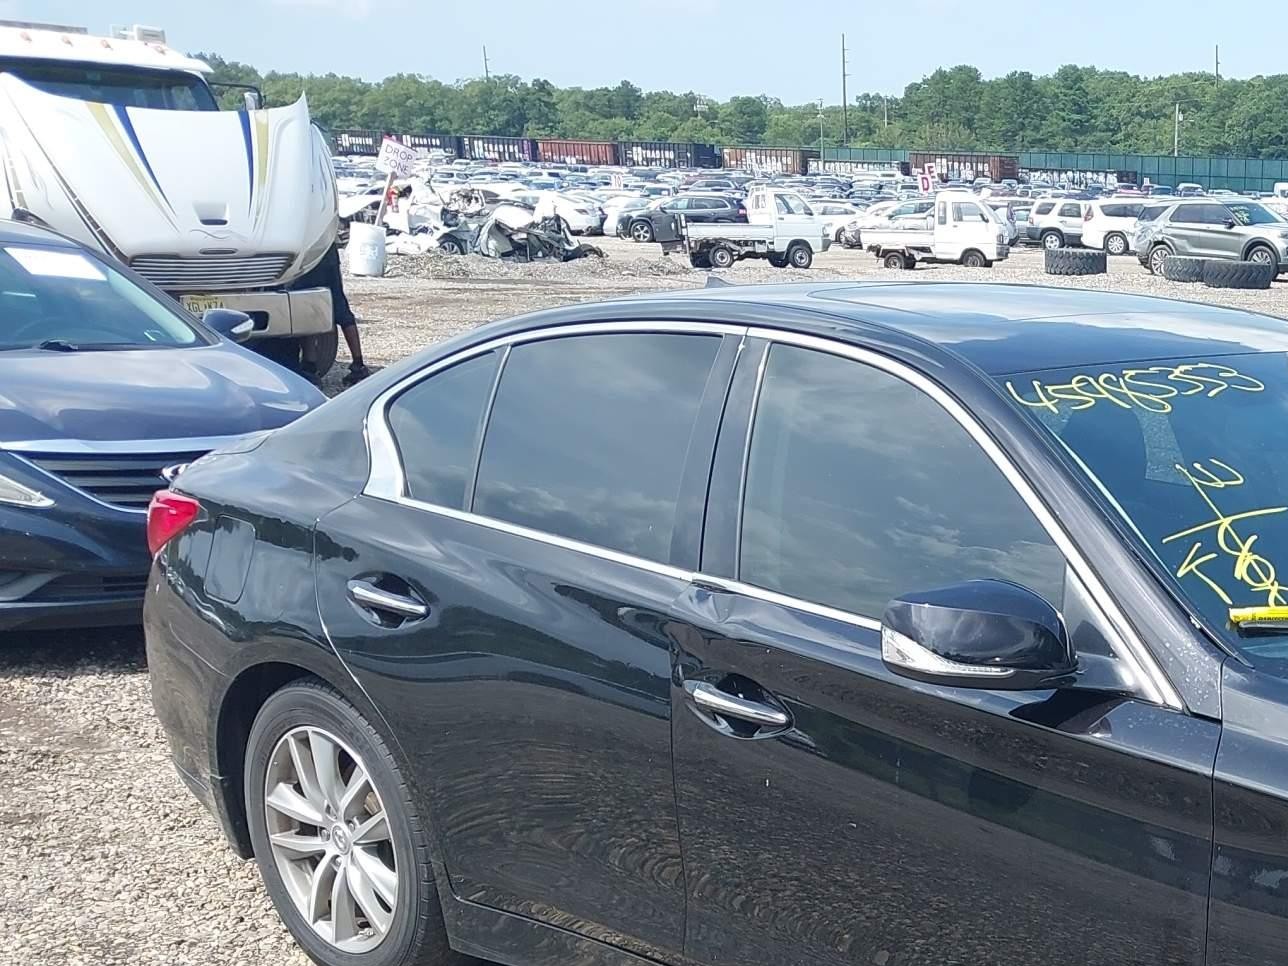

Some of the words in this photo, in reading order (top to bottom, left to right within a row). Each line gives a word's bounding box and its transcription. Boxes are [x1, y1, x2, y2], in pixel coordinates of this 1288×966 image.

[385, 144, 413, 162] DROP
[384, 156, 409, 175] ZONE
[947, 161, 989, 172] TRADING
[921, 176, 930, 192] D
